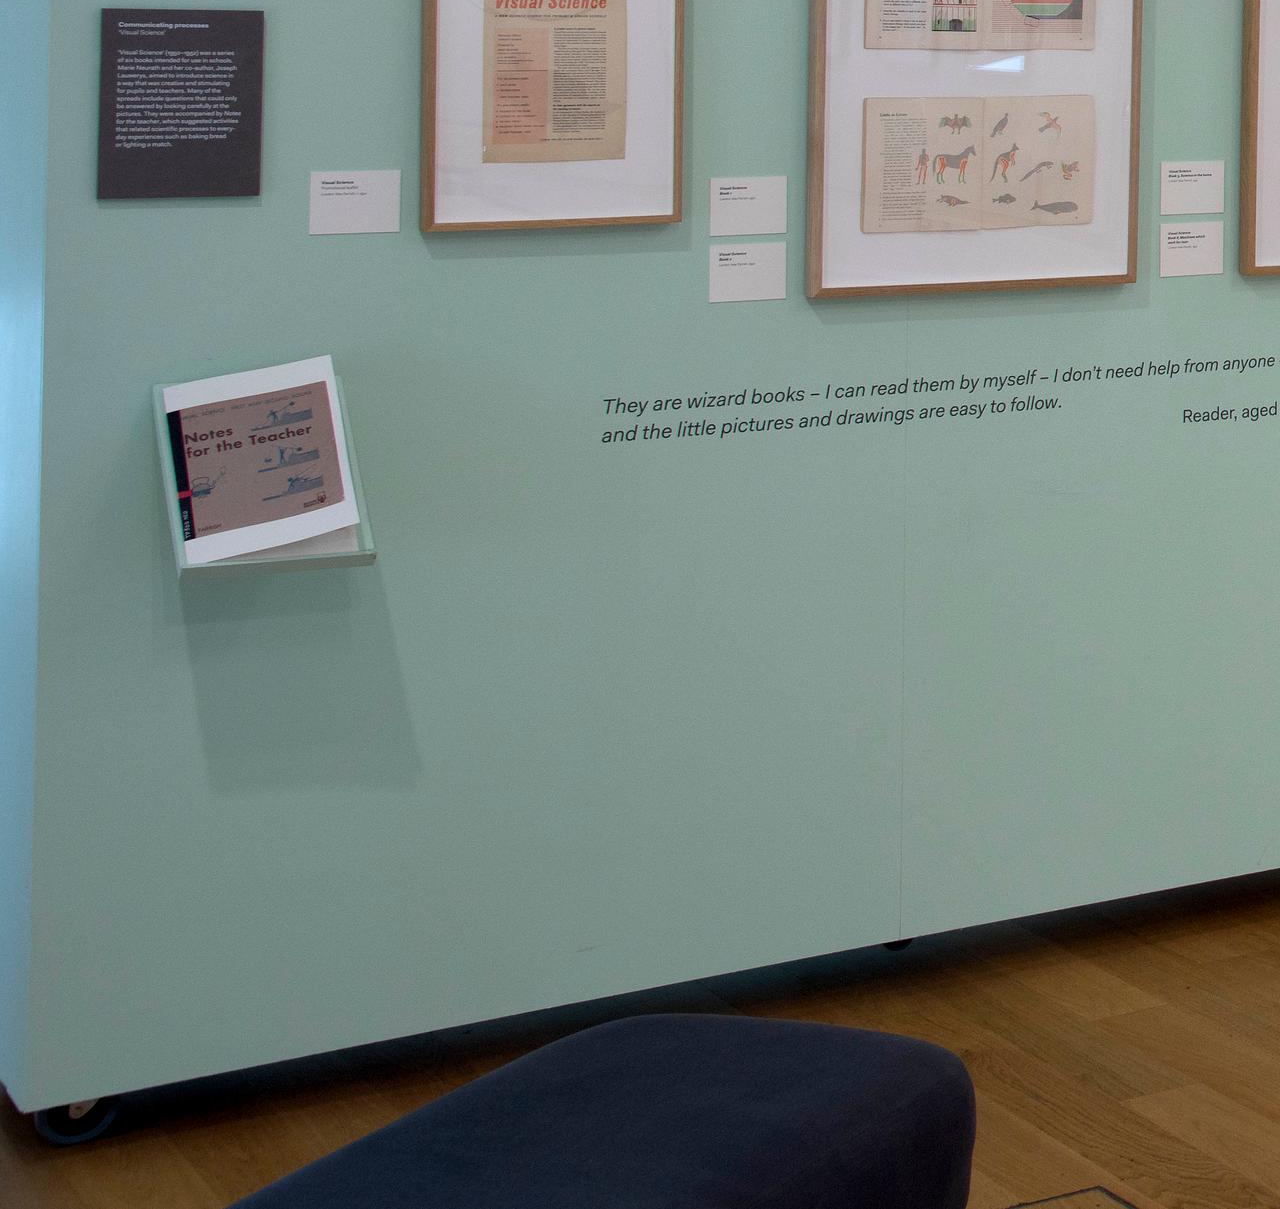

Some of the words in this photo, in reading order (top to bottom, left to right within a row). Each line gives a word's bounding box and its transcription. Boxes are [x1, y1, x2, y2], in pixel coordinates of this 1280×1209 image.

[603, 397, 649, 417] They
[652, 398, 683, 411] are
[687, 389, 747, 409] wizard
[751, 386, 805, 405] books
[825, 384, 831, 400] I
[835, 384, 866, 399] can
[870, 378, 909, 396] read
[913, 377, 955, 393] them
[960, 374, 980, 394] by
[983, 369, 1038, 392] myself
[1053, 369, 1059, 383] I
[1062, 365, 1102, 383] don't
[1105, 362, 1145, 379] need
[1147, 359, 1180, 379] help
[1184, 358, 1219, 374] from
[1222, 356, 1276, 374] anyone
[601, 425, 639, 443] and
[643, 423, 673, 440] the
[677, 420, 716, 438] little
[720, 417, 794, 439] pictures
[799, 410, 833, 428] and
[836, 406, 915, 426] drawings
[918, 405, 946, 420] are
[950, 402, 987, 420] easy
[990, 399, 1007, 414] to
[1010, 395, 1062, 412] follow.
[1182, 405, 1238, 423] Reader,
[1242, 401, 1278, 422] aged
[184, 428, 234, 445] Notes
[187, 446, 210, 459] for
[216, 439, 243, 453] the
[248, 425, 313, 446] Teacher
